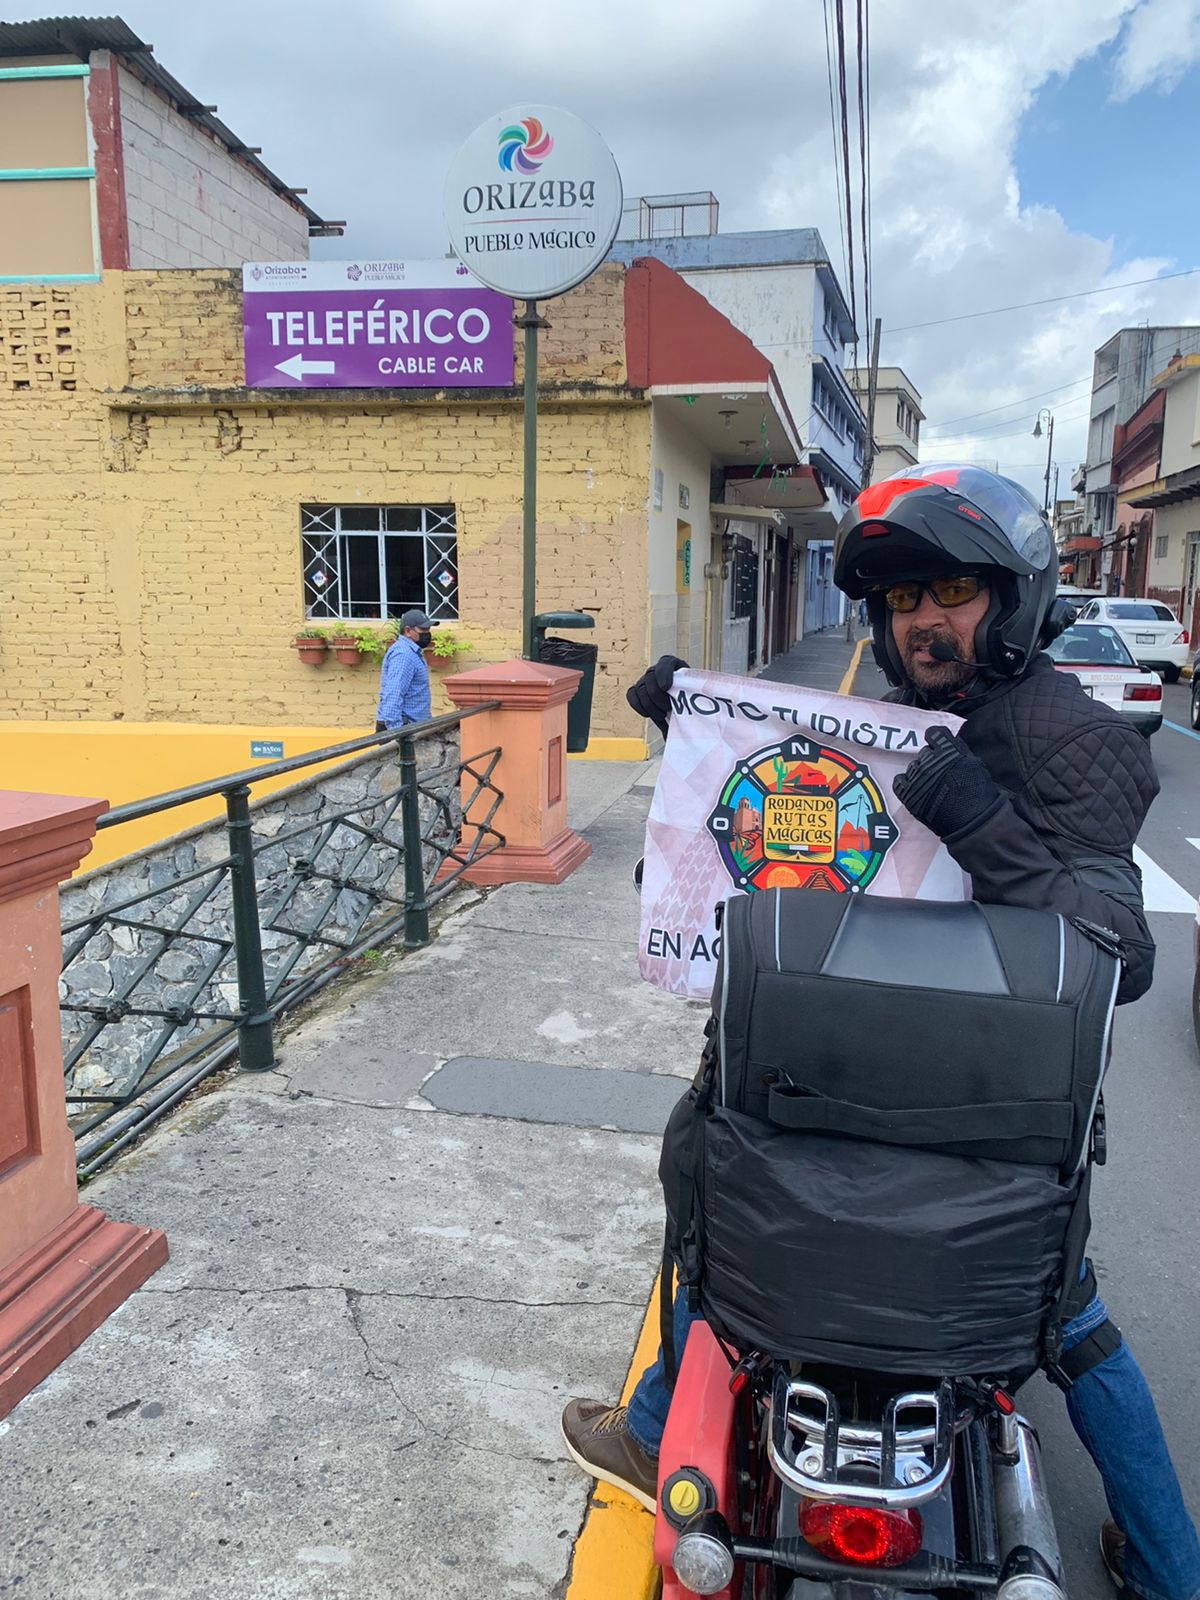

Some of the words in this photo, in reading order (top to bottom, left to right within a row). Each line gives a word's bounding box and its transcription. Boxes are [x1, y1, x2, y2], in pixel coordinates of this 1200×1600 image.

[264, 266, 300, 275] Orizaba
[266, 299, 491, 346] TELEFÉRICO
[378, 357, 436, 374] CABLE
[444, 357, 484, 373] CAR
[791, 742, 810, 756] N
[713, 817, 729, 830] O
[874, 825, 890, 839] E
[647, 928, 681, 959] EN
